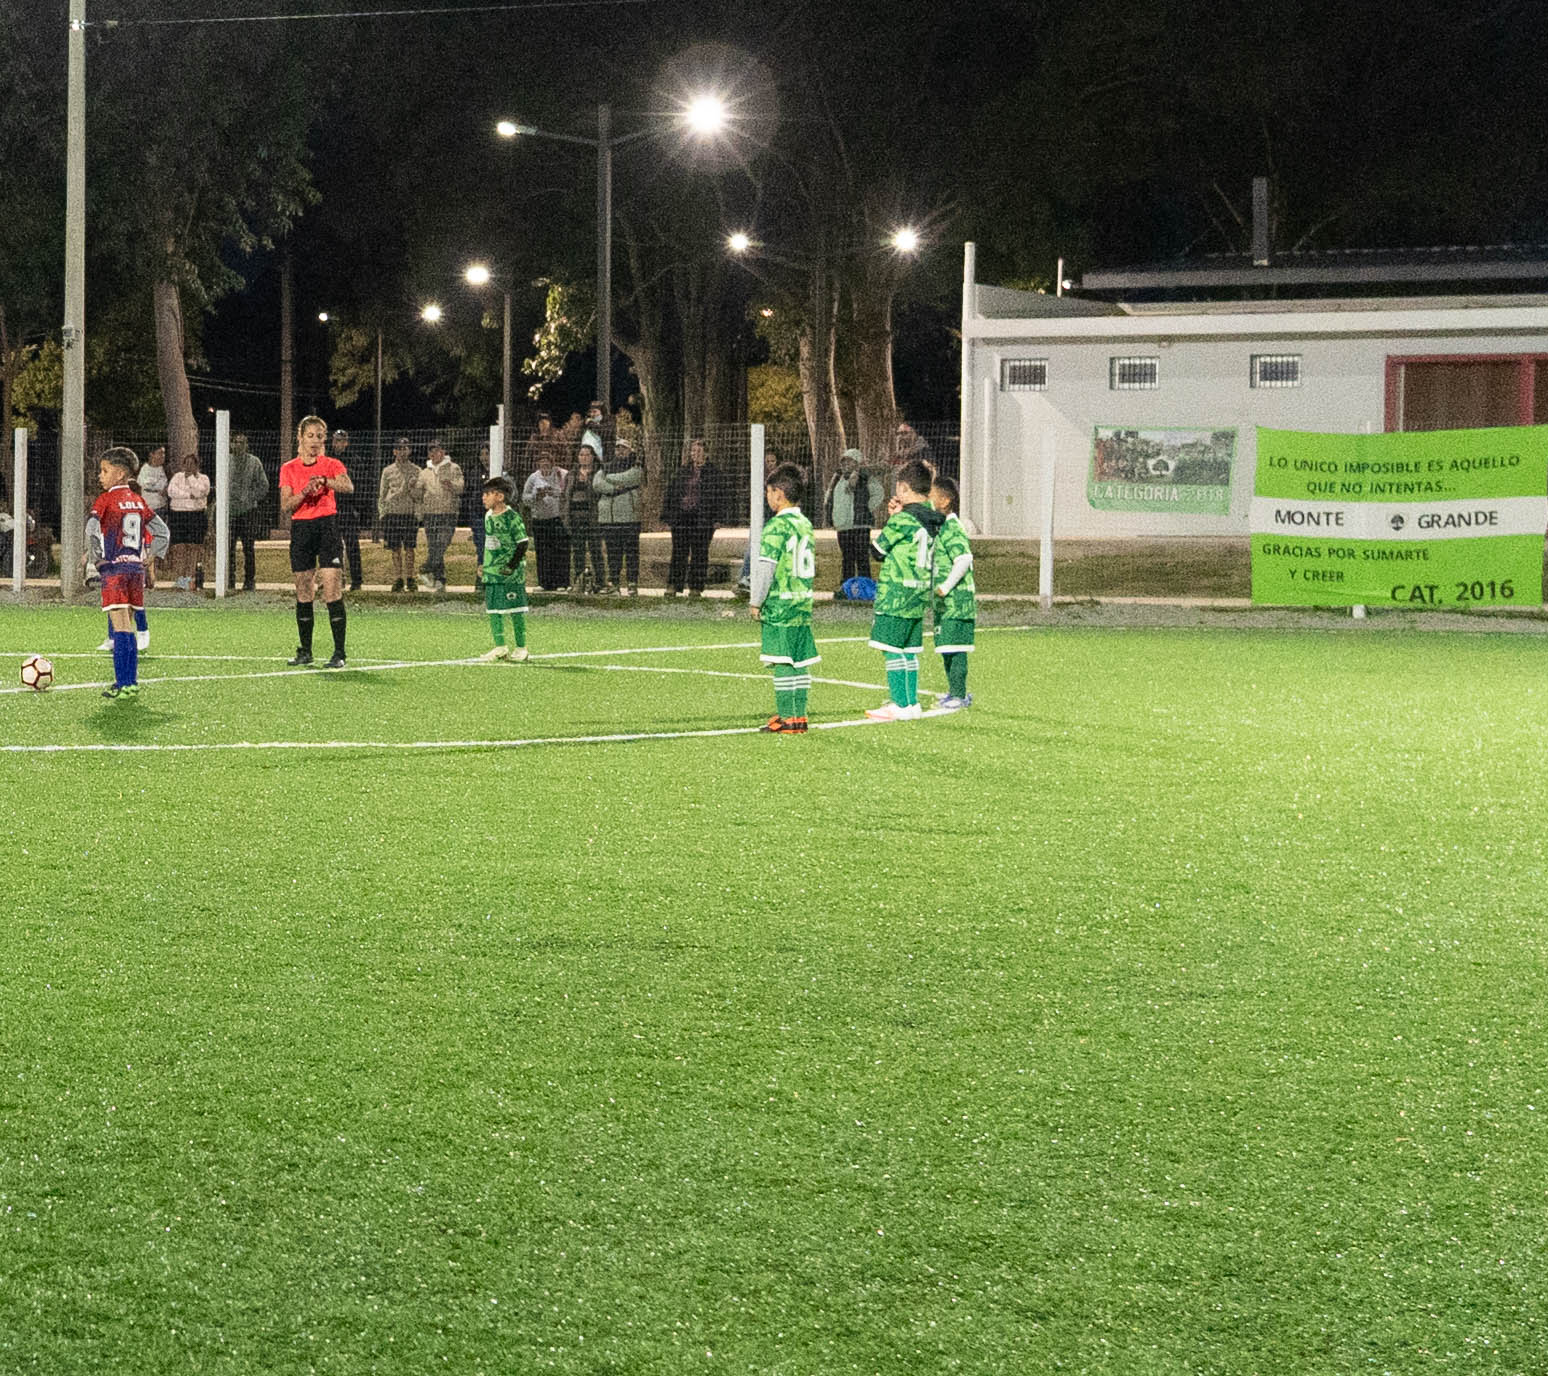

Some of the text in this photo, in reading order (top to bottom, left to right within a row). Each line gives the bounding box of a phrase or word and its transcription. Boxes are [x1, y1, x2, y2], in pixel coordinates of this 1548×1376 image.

[1268, 455, 1521, 475] LO UNICO IMPOSIBLE ES AQUELLO
[1094, 485, 1179, 502] CATEGORIA
[1307, 481, 1337, 496] QUE
[1340, 481, 1363, 495] NO
[1275, 509, 1499, 530] MONTE GRANDE
[122, 513, 141, 549] 9
[785, 535, 815, 578] 16
[1262, 542, 1430, 561] GRACIAS POR SUMARTE
[1289, 569, 1345, 583] Y CREER
[1456, 579, 1514, 601] 2016
